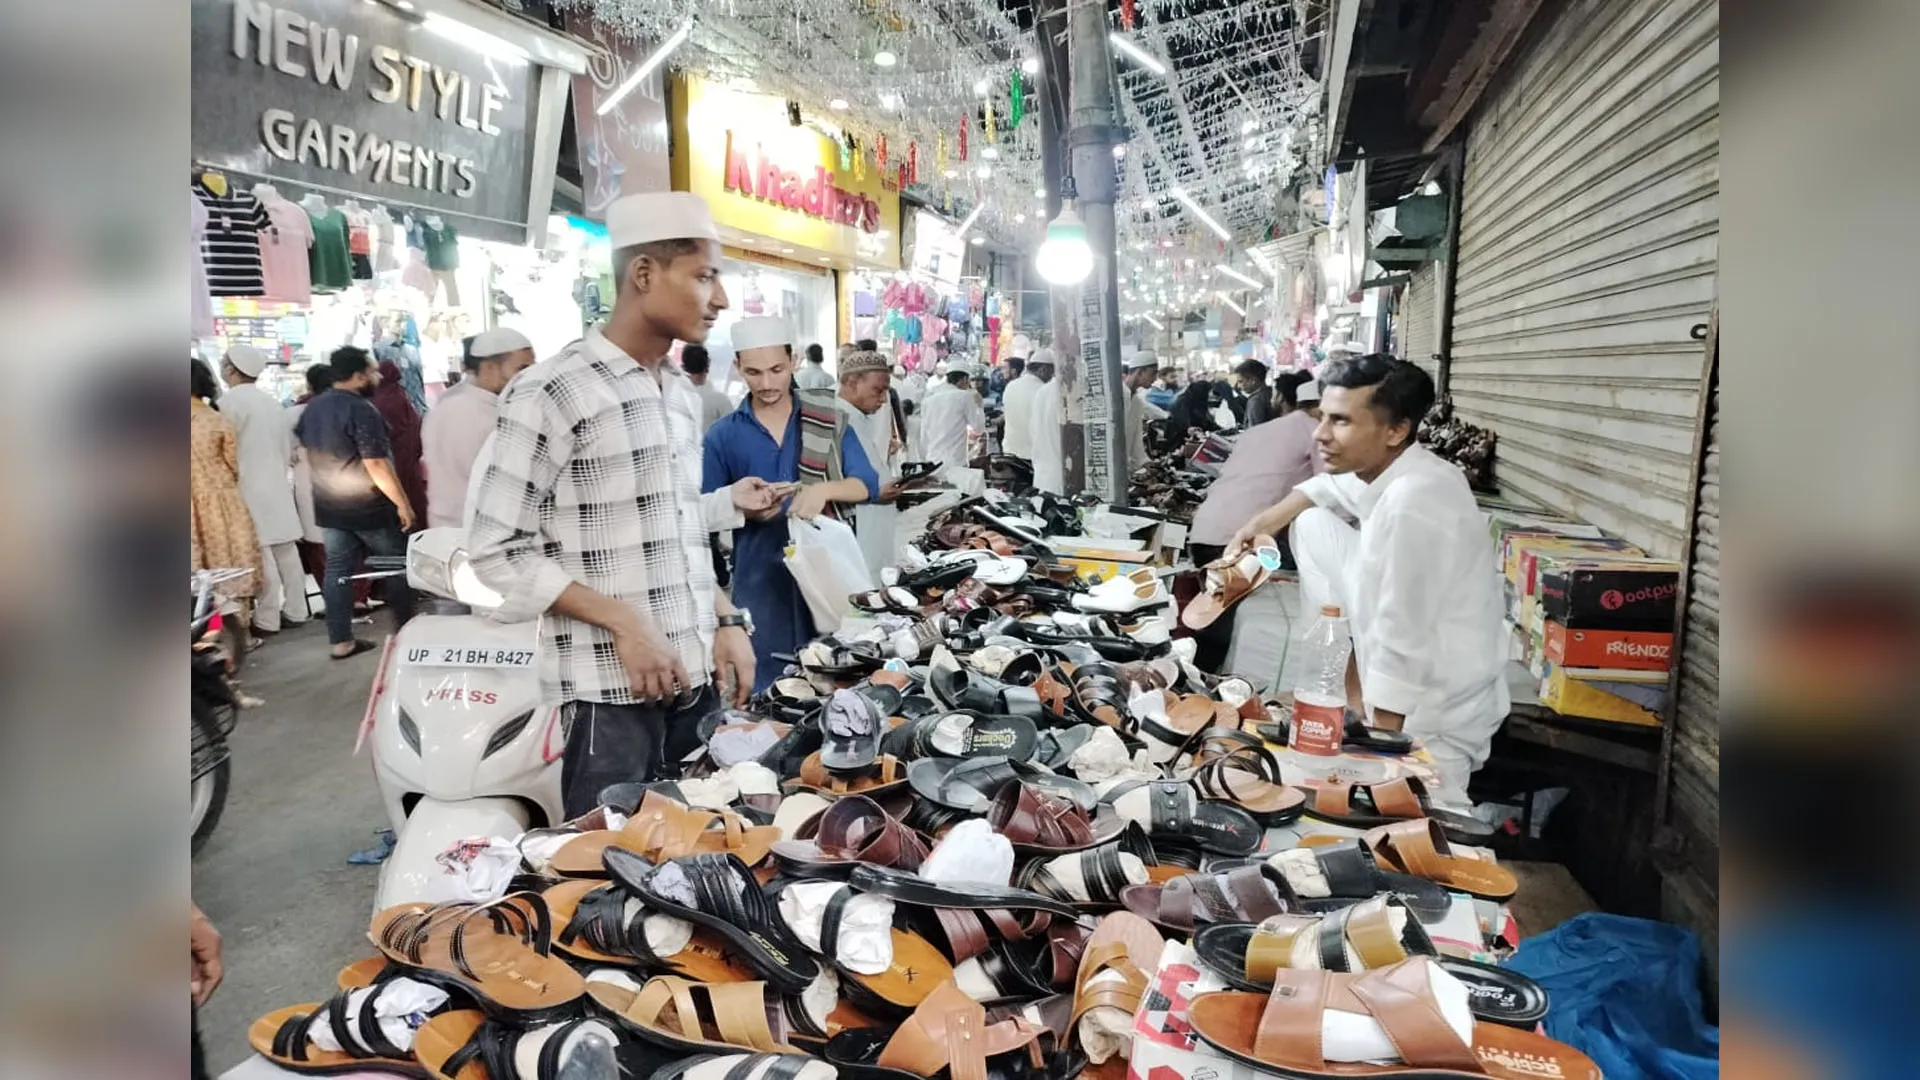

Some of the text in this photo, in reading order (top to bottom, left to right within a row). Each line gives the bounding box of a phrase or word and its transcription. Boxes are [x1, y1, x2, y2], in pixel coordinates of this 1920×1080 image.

[232, 0, 359, 90] NEW
[369, 43, 511, 137] STYLE
[261, 108, 477, 199] GARMENTS
[724, 129, 880, 233] Khadim's
[408, 648, 534, 665] UP 21 BH 8427
[426, 688, 498, 705] PRESS
